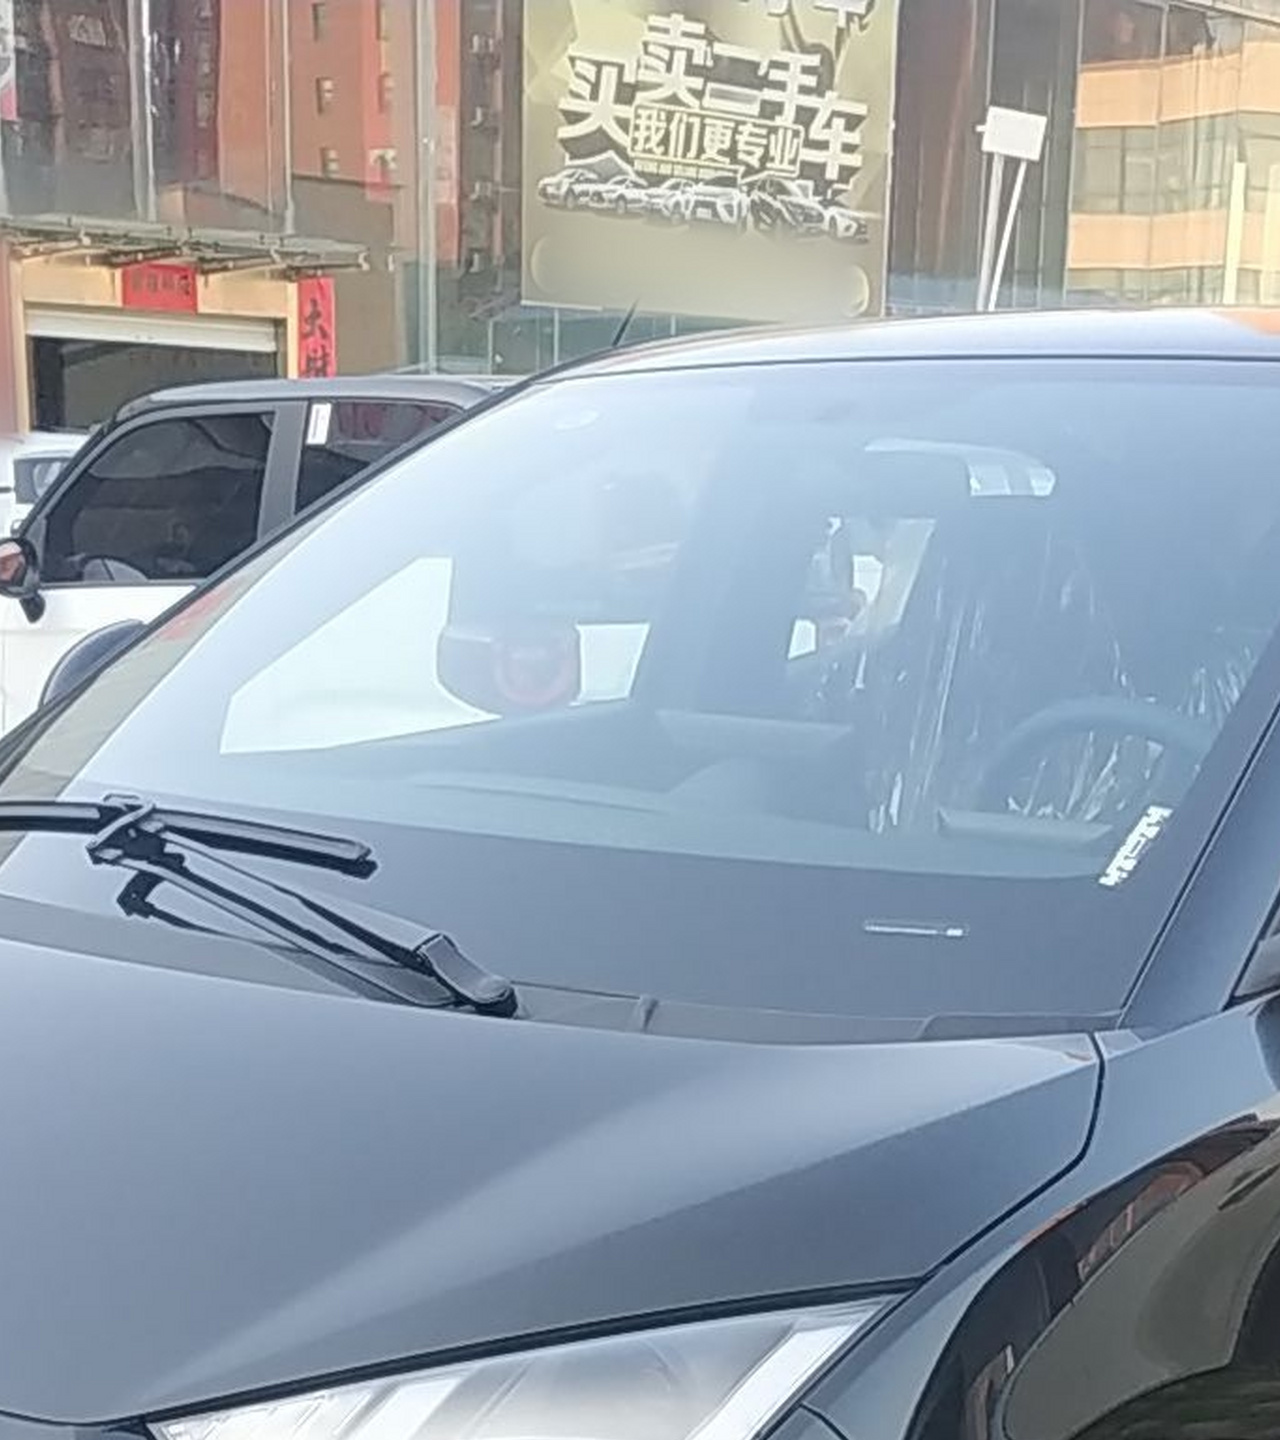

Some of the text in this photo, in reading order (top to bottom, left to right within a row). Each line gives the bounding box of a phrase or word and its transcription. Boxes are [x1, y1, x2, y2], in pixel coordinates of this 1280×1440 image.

[557, 12, 868, 181] 买卖二手车
[633, 107, 799, 171] 我们更专业
